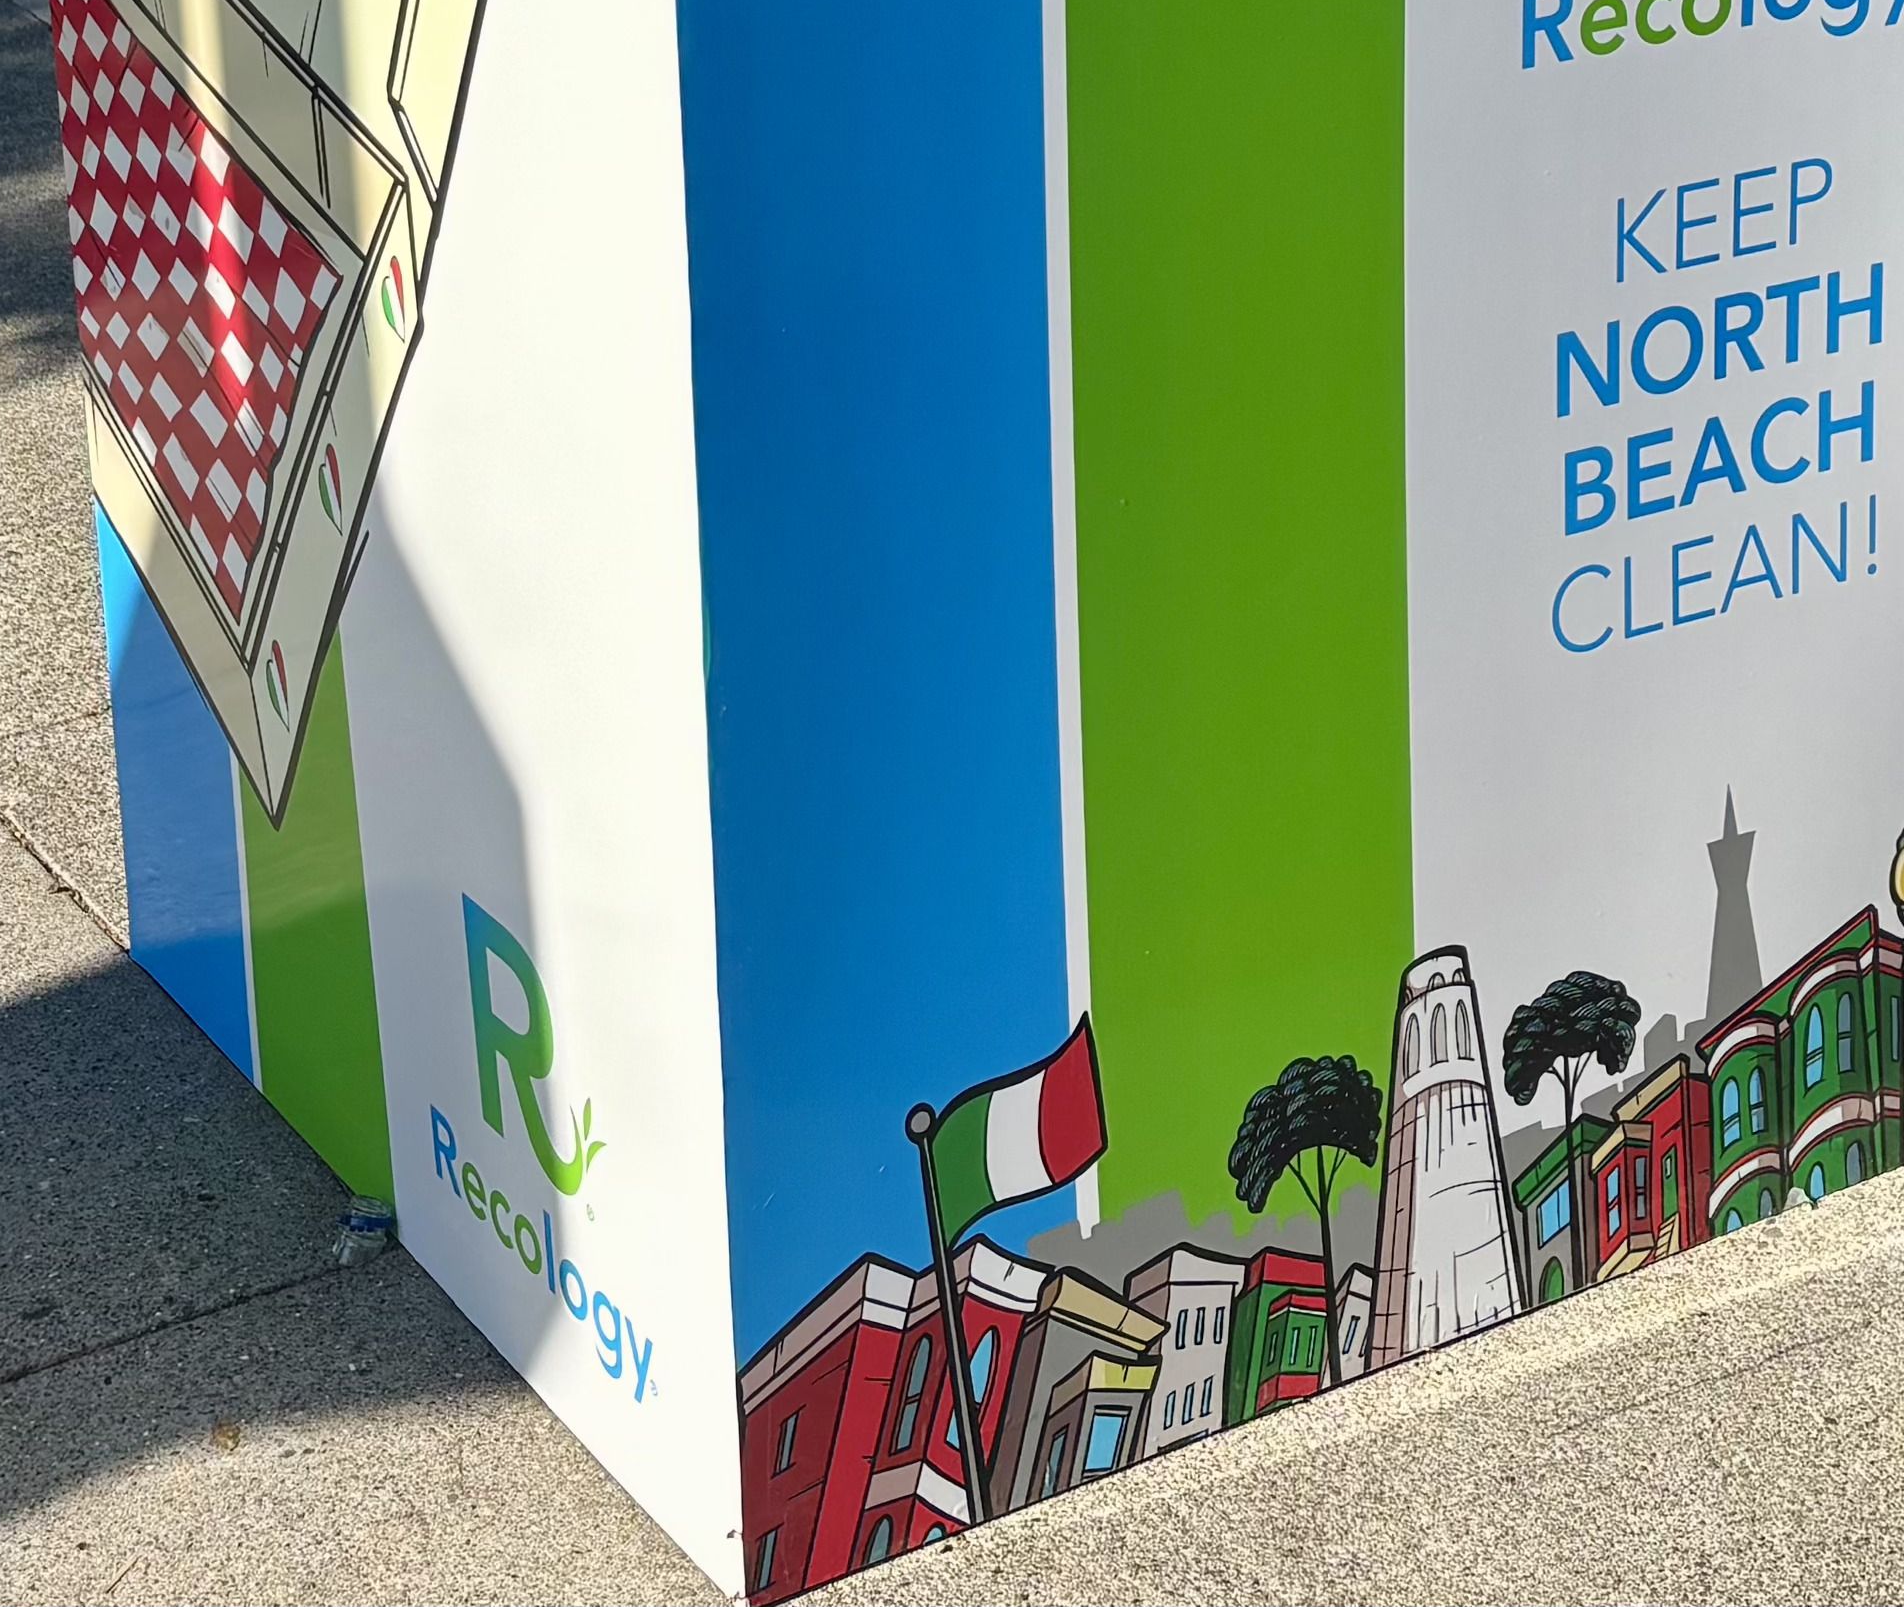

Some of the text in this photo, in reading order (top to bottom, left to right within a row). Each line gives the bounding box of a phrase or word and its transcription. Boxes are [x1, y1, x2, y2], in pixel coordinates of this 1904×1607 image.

[1616, 157, 1833, 283] KEEP
[1557, 262, 1884, 418] NORTH
[1564, 380, 1875, 536] BEACH
[1552, 494, 1877, 653] CLEAN!
